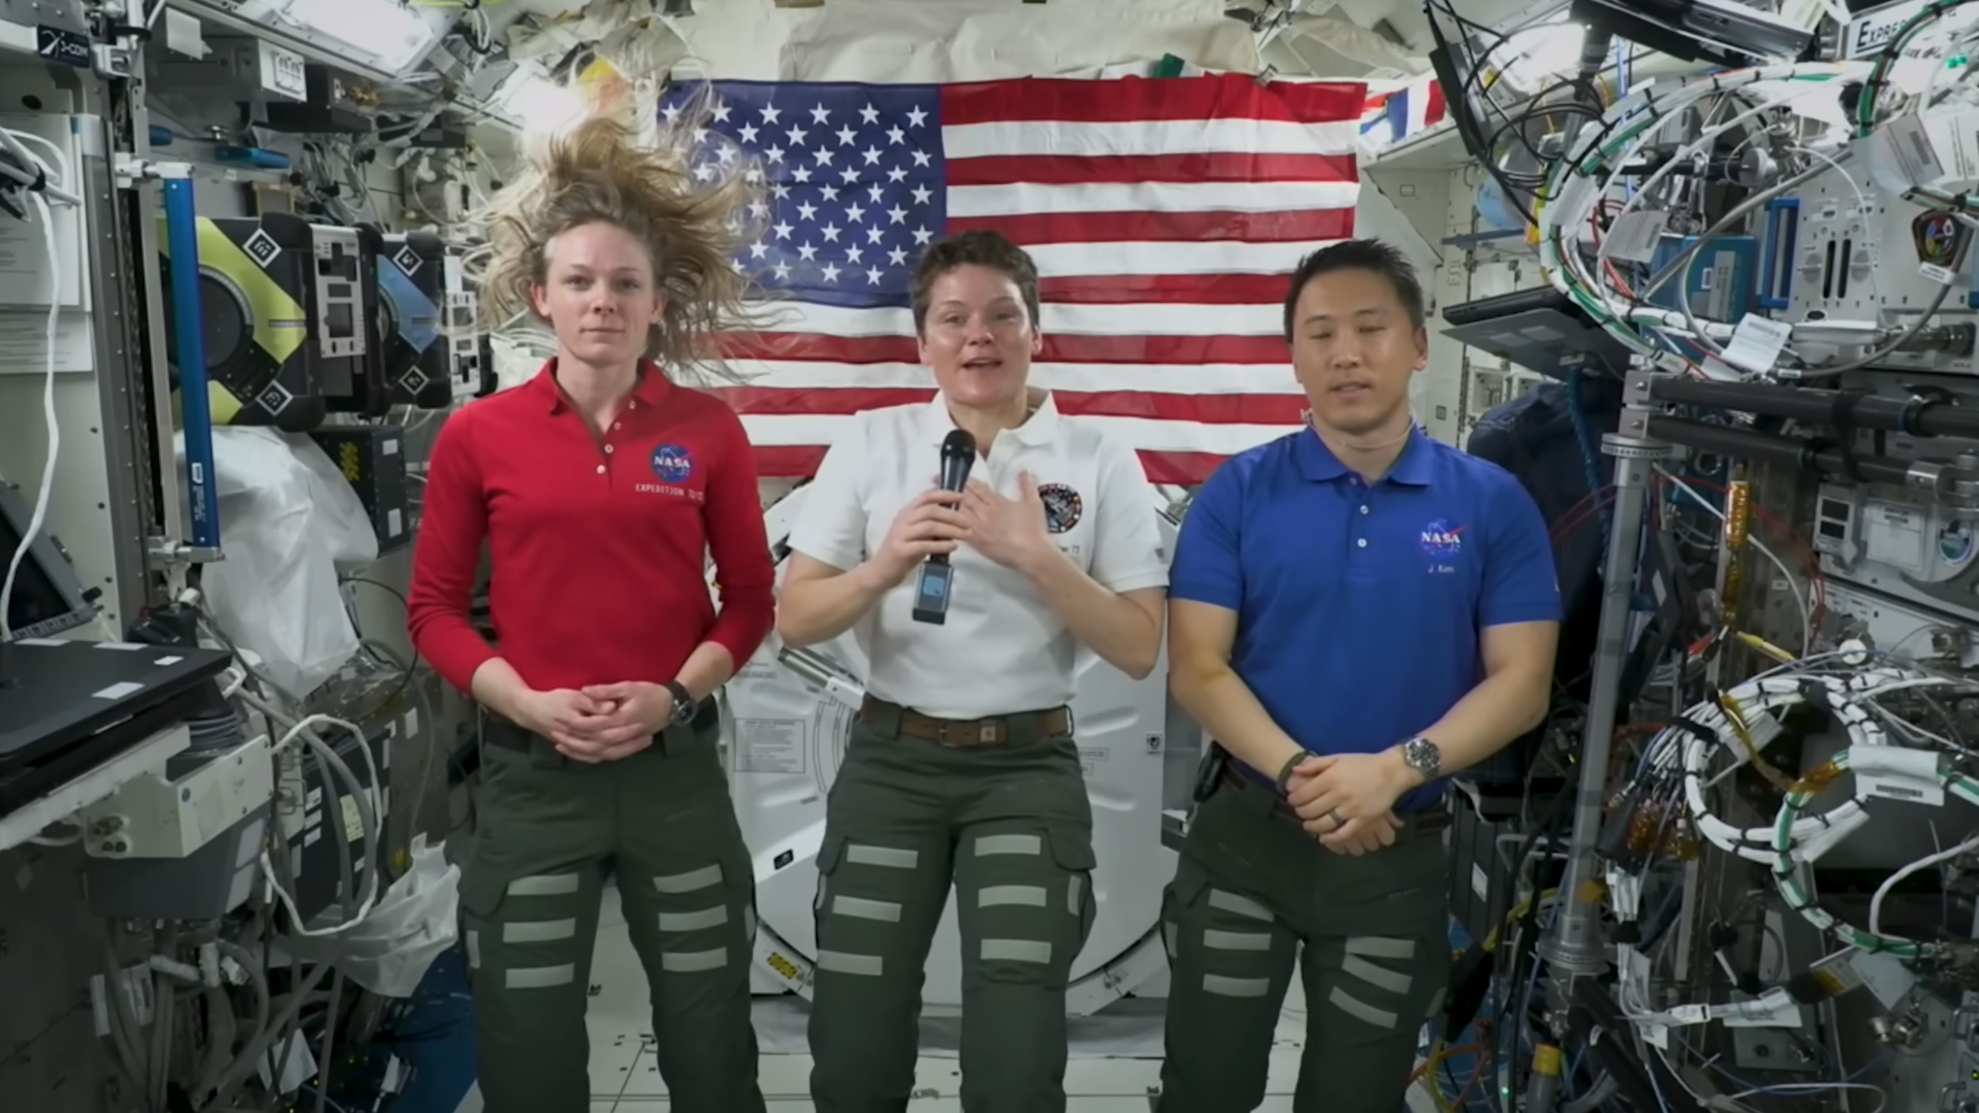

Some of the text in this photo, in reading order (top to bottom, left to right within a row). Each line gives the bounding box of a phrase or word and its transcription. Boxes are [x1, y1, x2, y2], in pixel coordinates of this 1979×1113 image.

[654, 455, 691, 468] NASA
[635, 483, 685, 497] EXPEDITION
[1421, 531, 1461, 544] NASA
